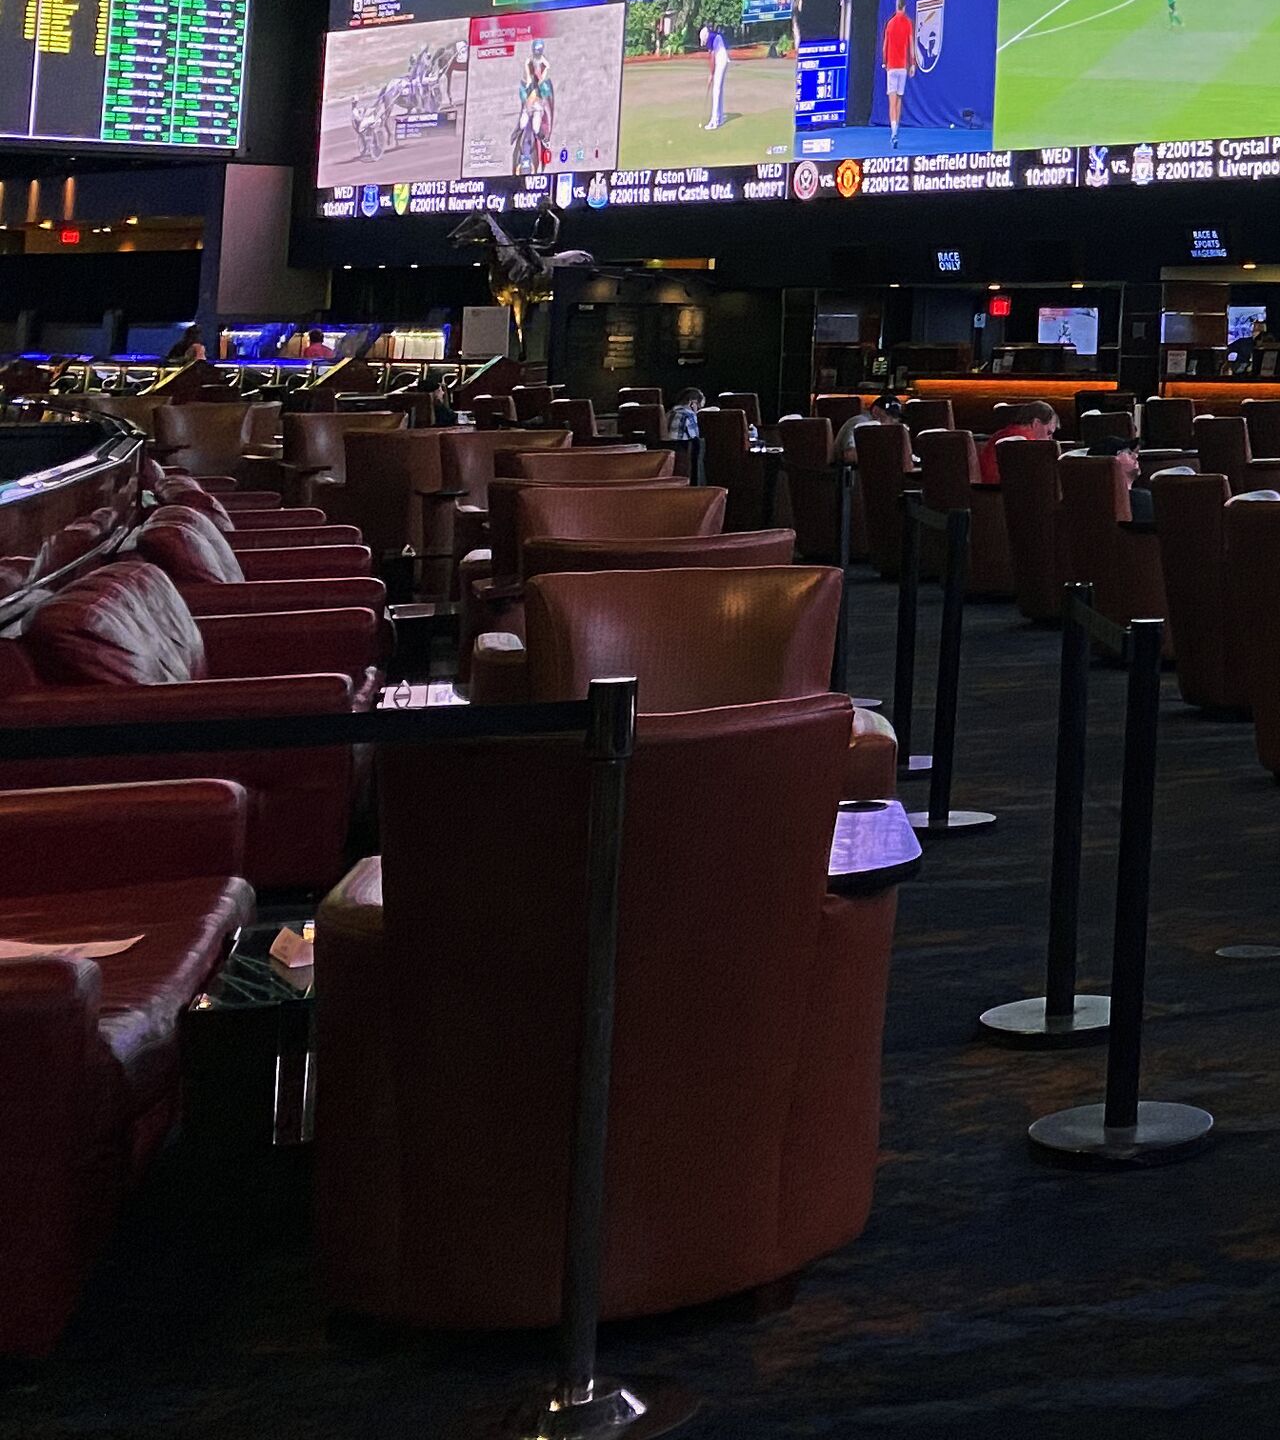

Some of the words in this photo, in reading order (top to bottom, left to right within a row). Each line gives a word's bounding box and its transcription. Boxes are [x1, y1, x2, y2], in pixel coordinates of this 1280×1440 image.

[1042, 149, 1070, 164] WED
[1157, 141, 1213, 159] #200125
[1219, 138, 1269, 158] Crystal
[862, 157, 908, 173] #200121
[913, 155, 968, 172] Sheffield
[970, 152, 1010, 169] United
[1157, 161, 1213, 180] #200126
[611, 172, 650, 186] #200117
[655, 170, 684, 184] Aston
[687, 169, 708, 183] Villa
[757, 164, 782, 179] WED
[1025, 169, 1074, 186] 10:00PT
[411, 182, 446, 196] #200113
[450, 180, 484, 193] Everton
[525, 176, 547, 190] WED
[743, 182, 784, 198] 10:00PT
[862, 177, 909, 194] #200122
[913, 175, 984, 191] Manchester
[334, 187, 353, 199] WED
[609, 189, 650, 204] #200118
[654, 187, 675, 202] New
[678, 186, 709, 201] Castle
[410, 198, 445, 213] #200114
[487, 196, 505, 213] City
[1194, 240, 1220, 248] SPORTS
[937, 252, 960, 261] RACE
[939, 261, 961, 271] ONLY
